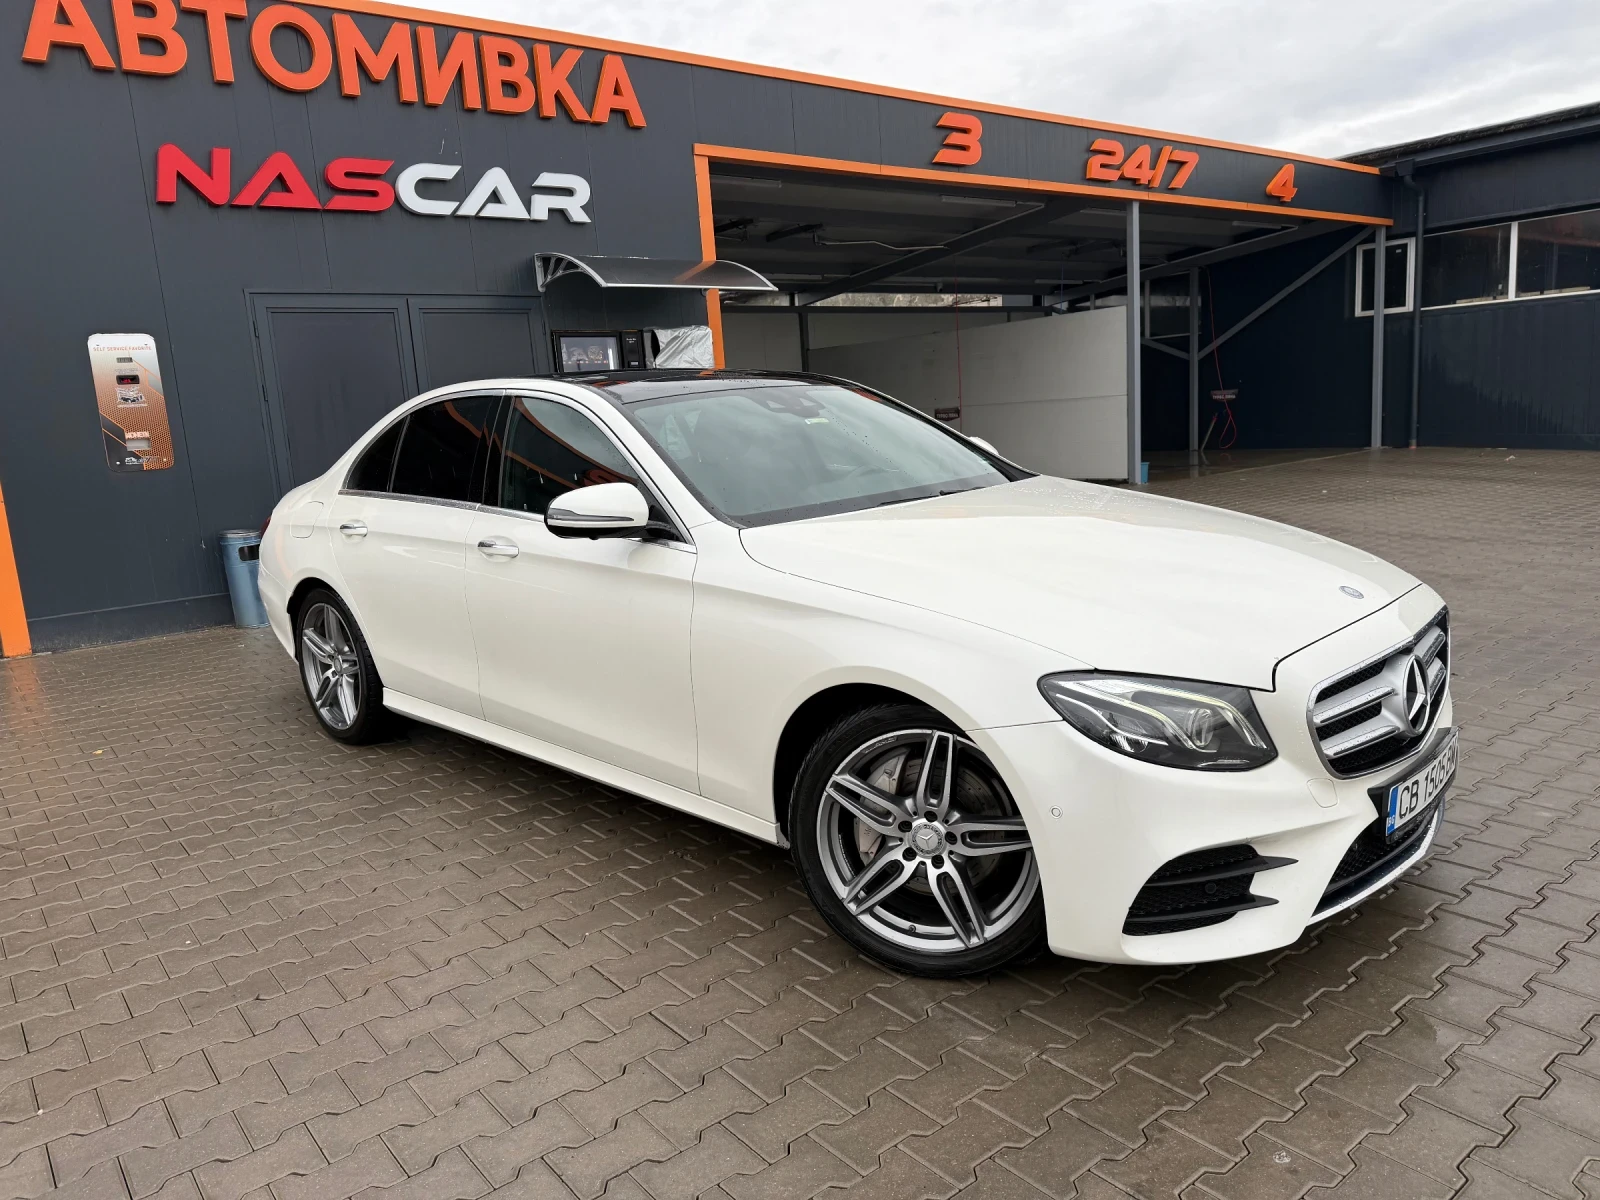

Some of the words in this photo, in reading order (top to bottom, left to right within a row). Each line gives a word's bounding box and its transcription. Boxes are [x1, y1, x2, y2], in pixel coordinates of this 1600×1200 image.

[22, 0, 647, 128] АВТОМИВКА
[932, 112, 983, 167] 3
[1086, 138, 1200, 189] 24/7
[156, 143, 592, 223] NASCAR
[1265, 163, 1298, 202] 4
[1399, 779, 1419, 820] CB
[1424, 752, 1446, 802] 1505
